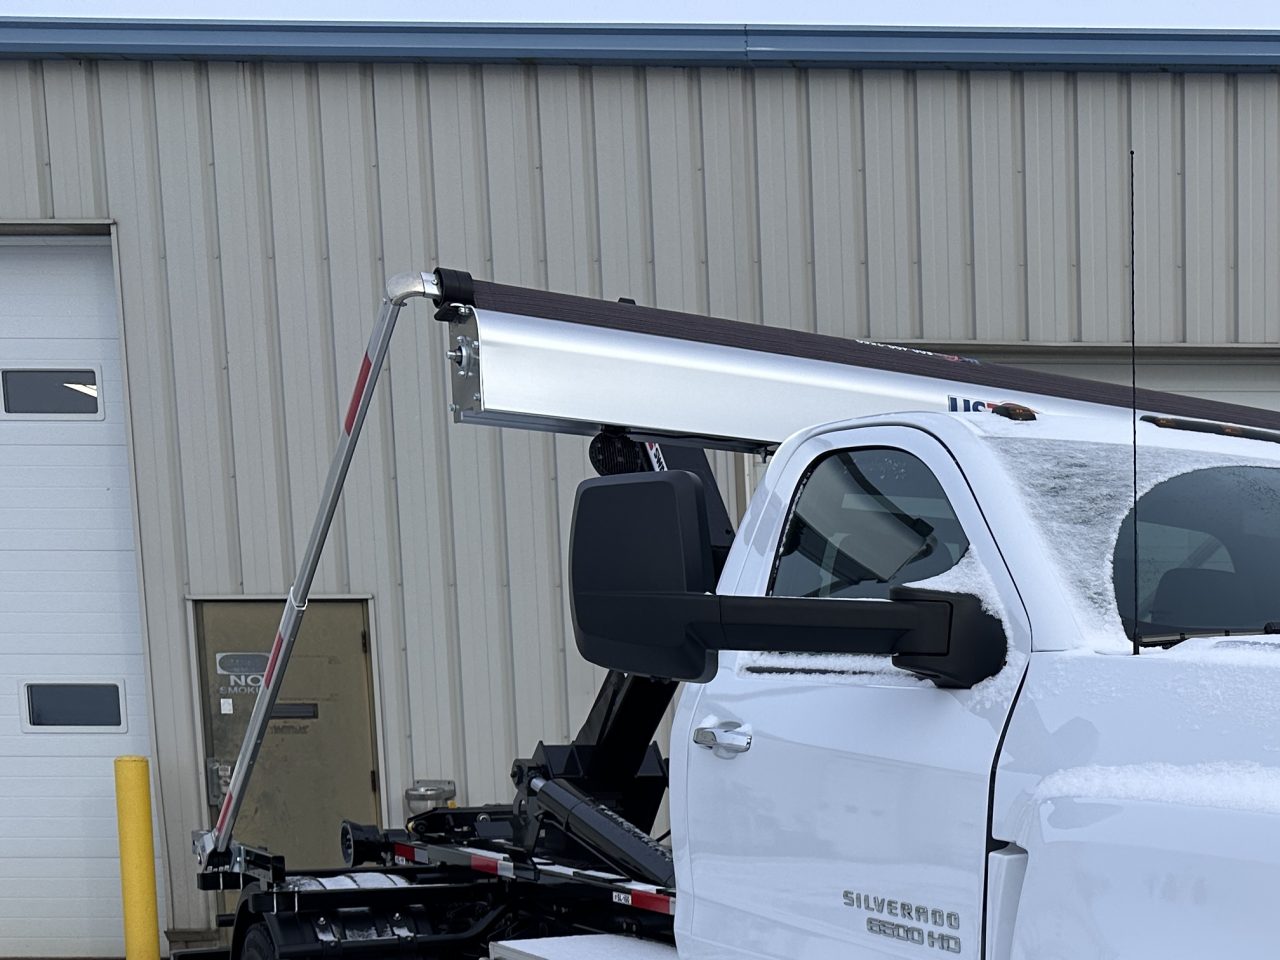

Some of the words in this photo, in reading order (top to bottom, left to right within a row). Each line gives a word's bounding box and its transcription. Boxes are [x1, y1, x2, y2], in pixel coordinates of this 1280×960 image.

[220, 686, 261, 695] SMOKI
[229, 674, 264, 687] NO
[842, 889, 960, 931] SILVERADO
[866, 916, 924, 946] 6500
[927, 930, 961, 954] HD
